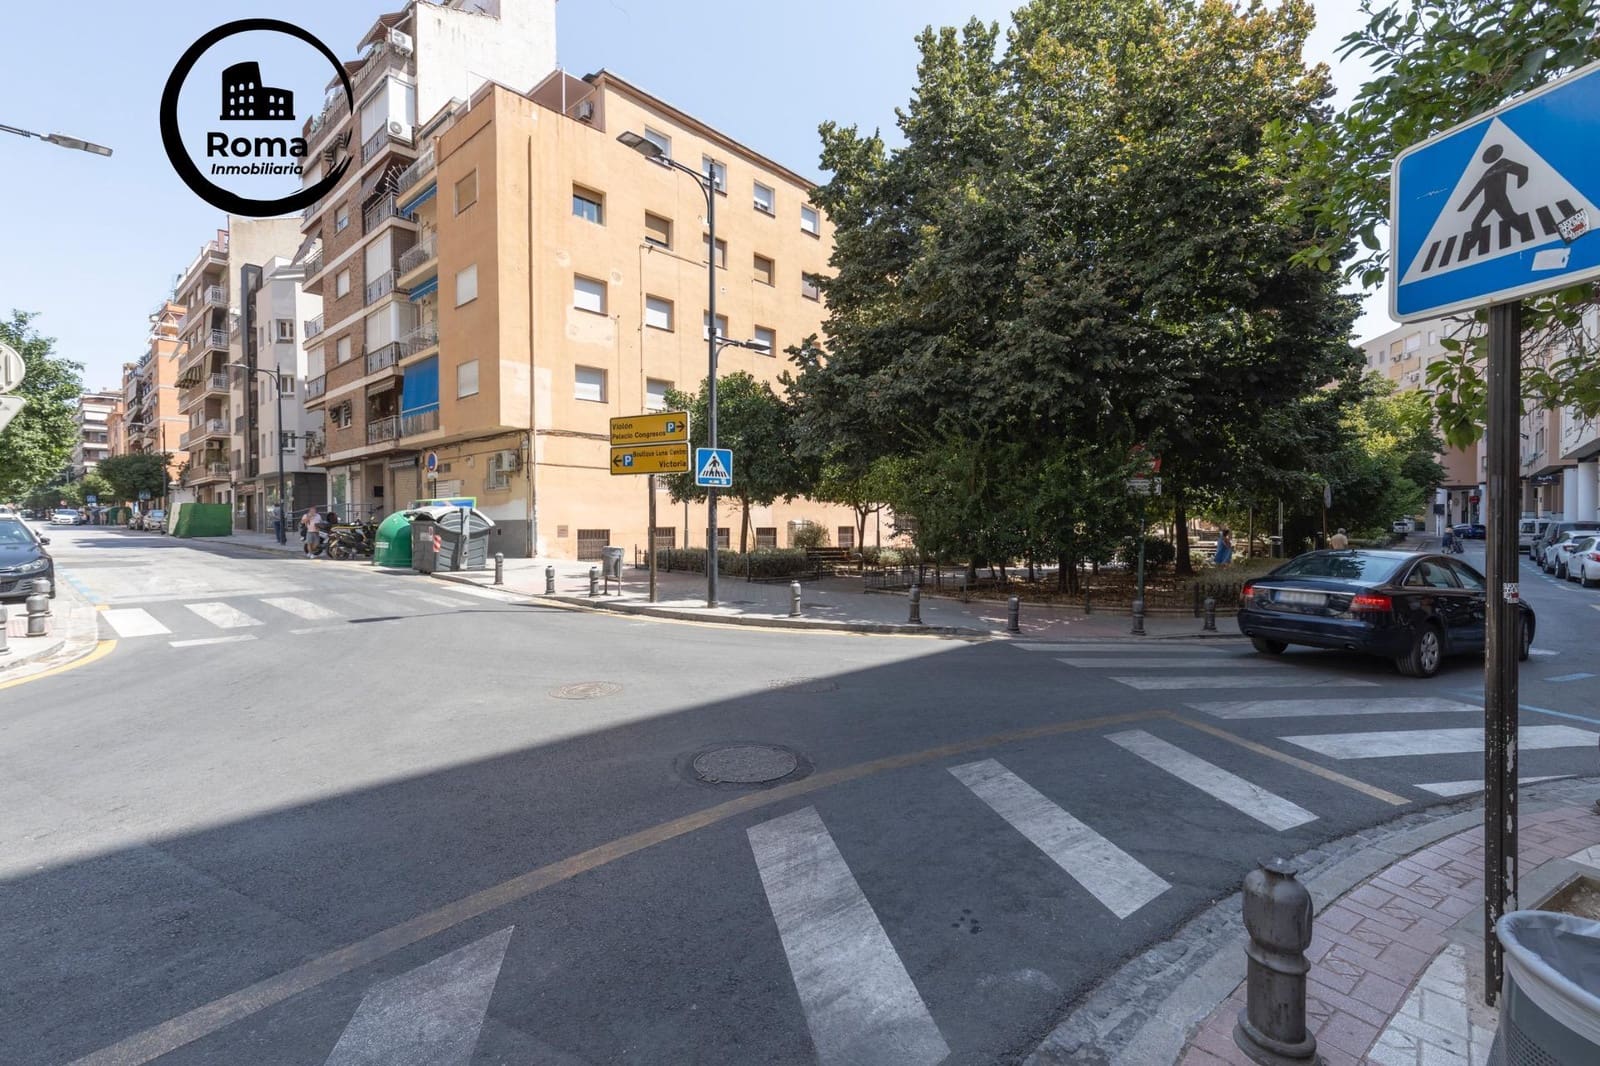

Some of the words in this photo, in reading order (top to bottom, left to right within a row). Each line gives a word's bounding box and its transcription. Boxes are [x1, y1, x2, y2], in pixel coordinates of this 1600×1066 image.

[667, 422, 674, 432] P
[624, 455, 632, 466] P
[659, 459, 687, 468] Victoria
